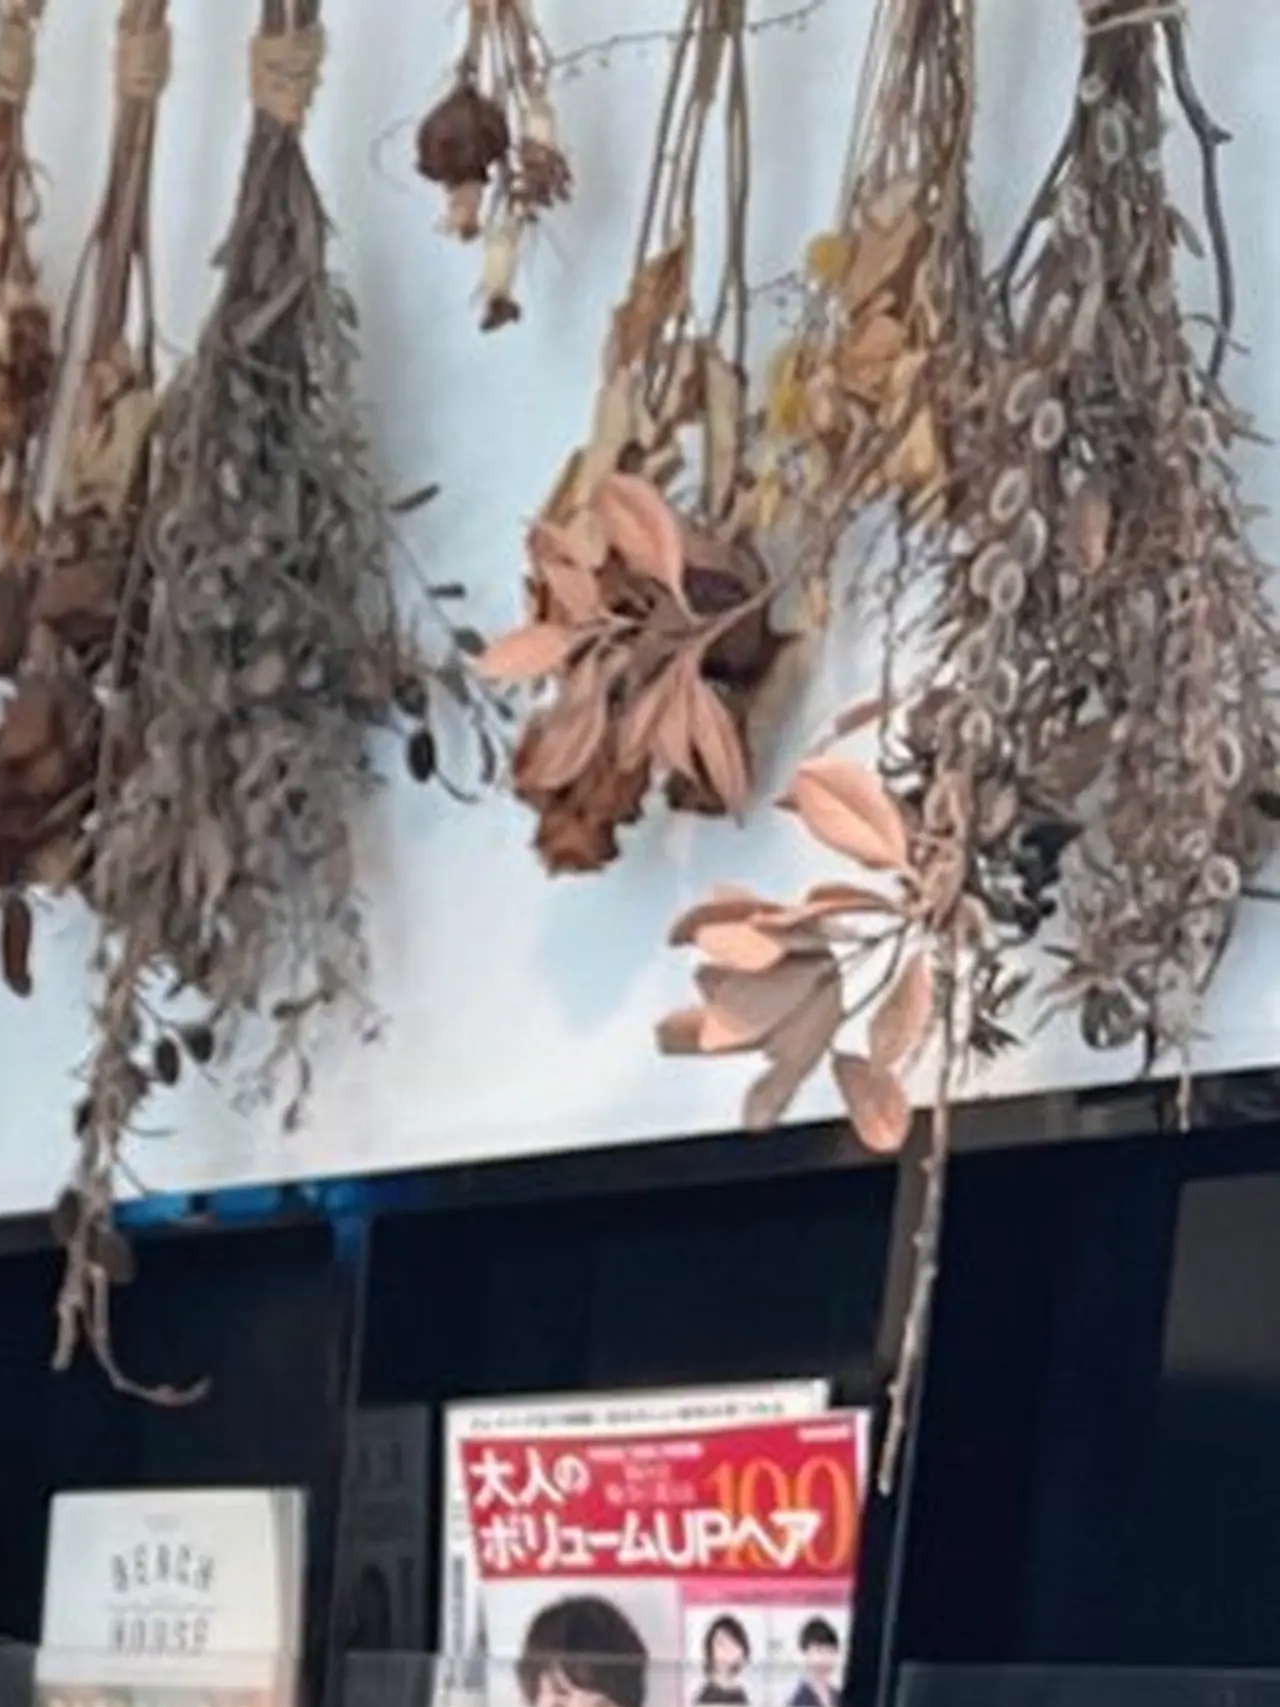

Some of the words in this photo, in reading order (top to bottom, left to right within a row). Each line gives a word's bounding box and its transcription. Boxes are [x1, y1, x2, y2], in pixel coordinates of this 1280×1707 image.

[469, 1445, 590, 1508] 大人の
[479, 1507, 823, 1569] ボリュームUPヘア
